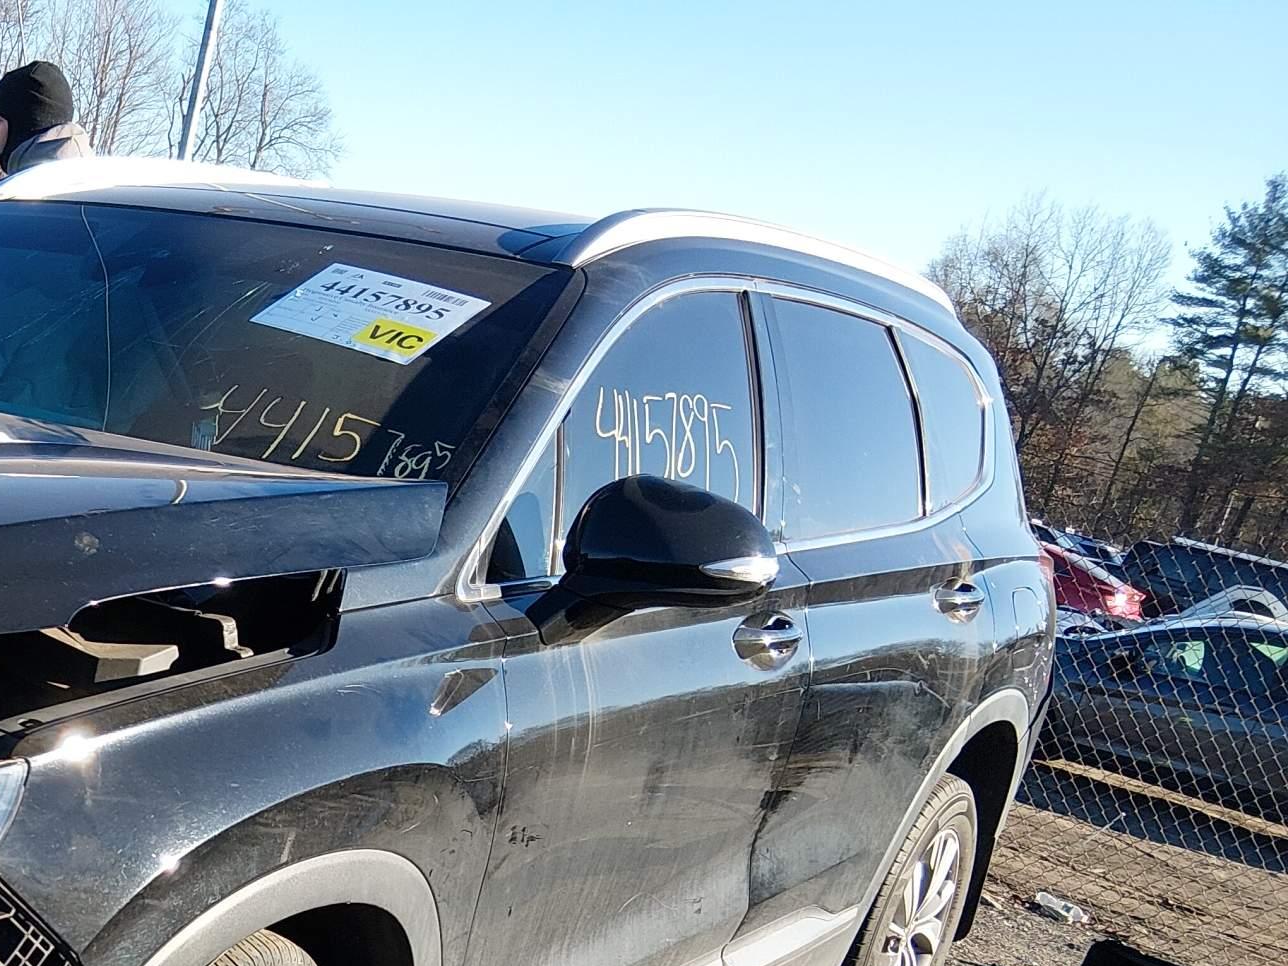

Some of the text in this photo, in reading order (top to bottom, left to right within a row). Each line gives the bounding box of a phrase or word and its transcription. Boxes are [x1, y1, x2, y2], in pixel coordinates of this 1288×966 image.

[320, 280, 451, 320] 44157895
[369, 324, 424, 350] VIC
[595, 386, 739, 504] 44157895
